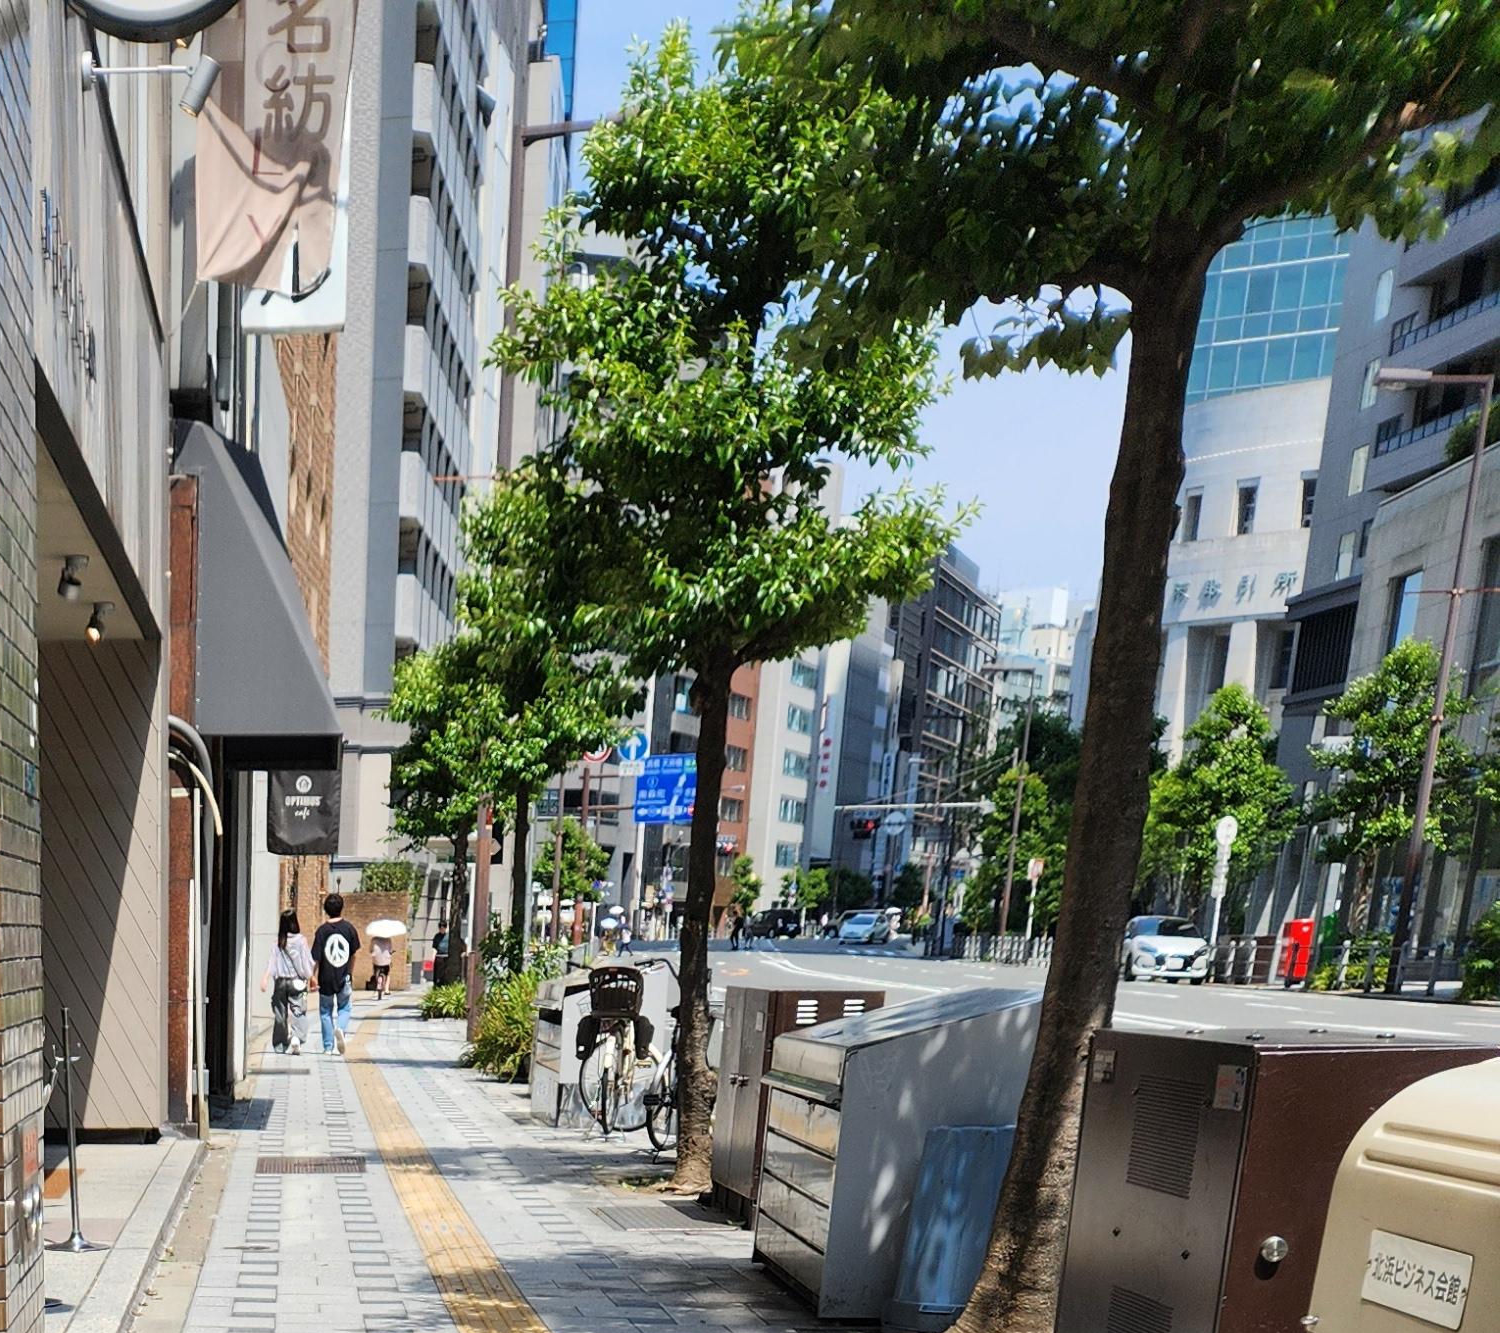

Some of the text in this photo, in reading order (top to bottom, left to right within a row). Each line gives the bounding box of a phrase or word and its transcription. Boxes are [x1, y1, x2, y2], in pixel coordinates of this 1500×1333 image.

[1371, 1252, 1462, 1306] 北浜ビジネス会館
